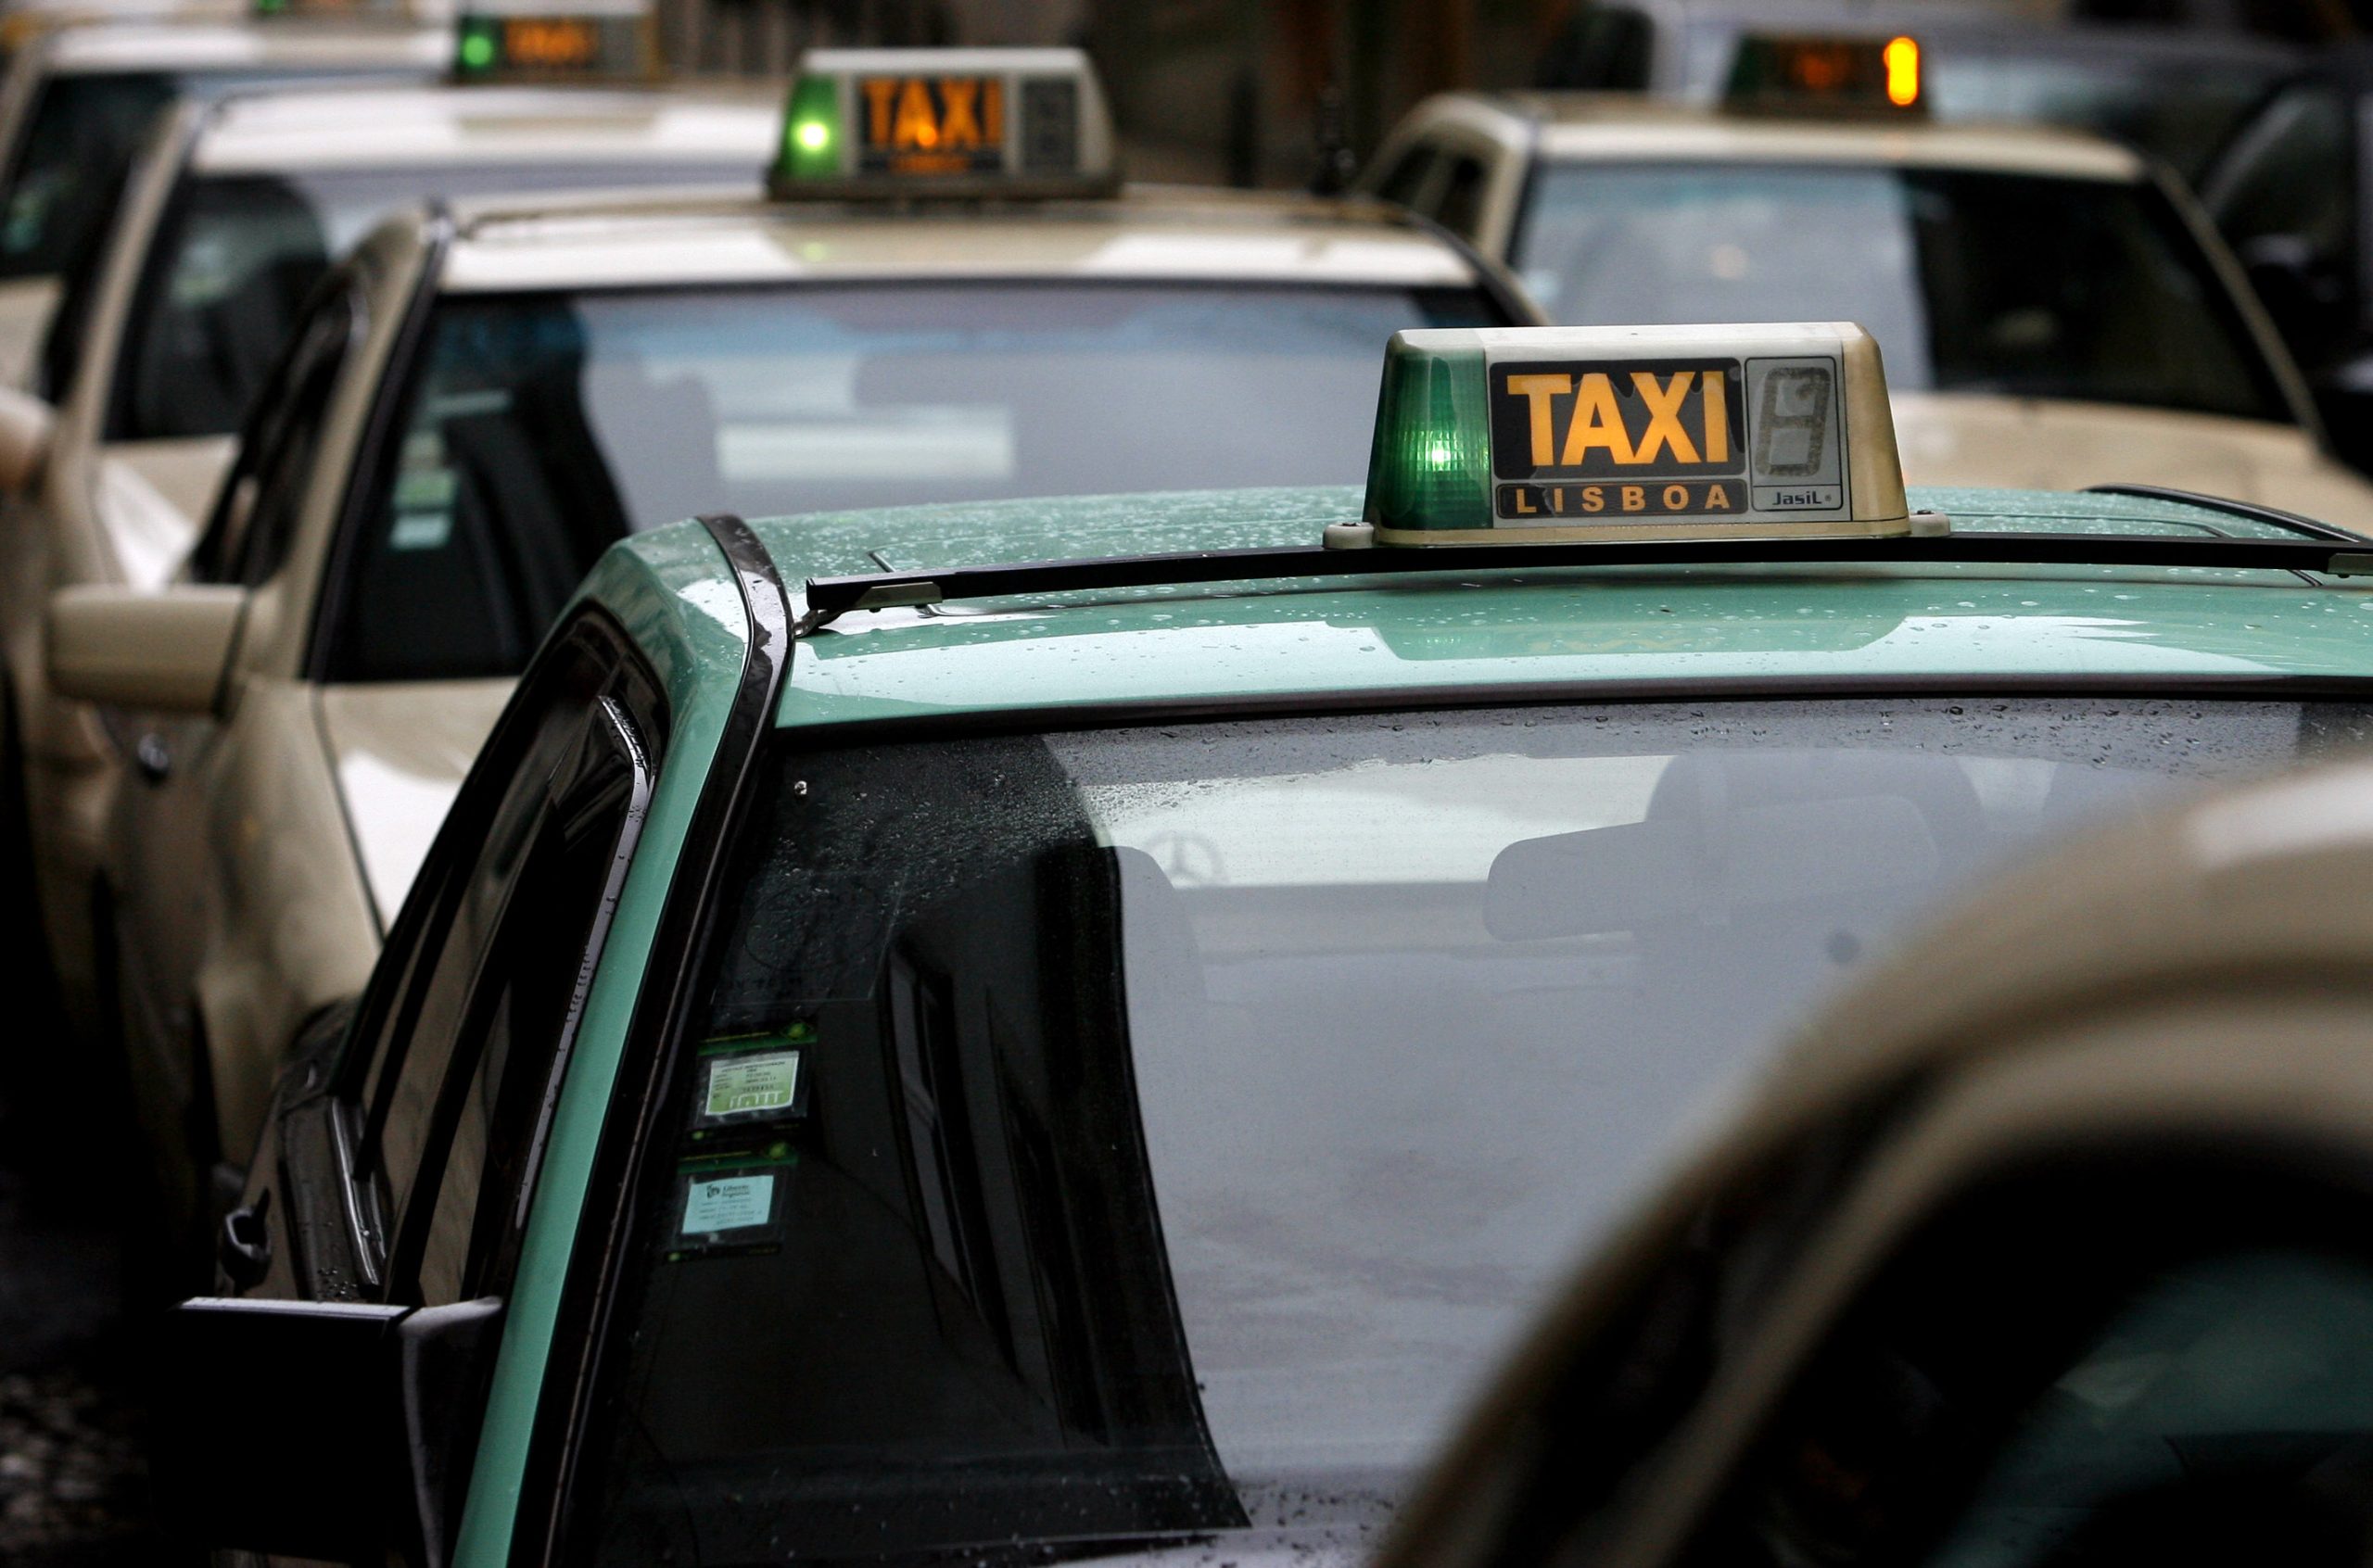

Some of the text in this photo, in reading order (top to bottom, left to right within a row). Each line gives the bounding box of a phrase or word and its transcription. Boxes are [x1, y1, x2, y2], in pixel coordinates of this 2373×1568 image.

[862, 78, 1003, 149] TAXI
[1506, 371, 1730, 467] TAXI
[1516, 485, 1732, 514] LISBOA
